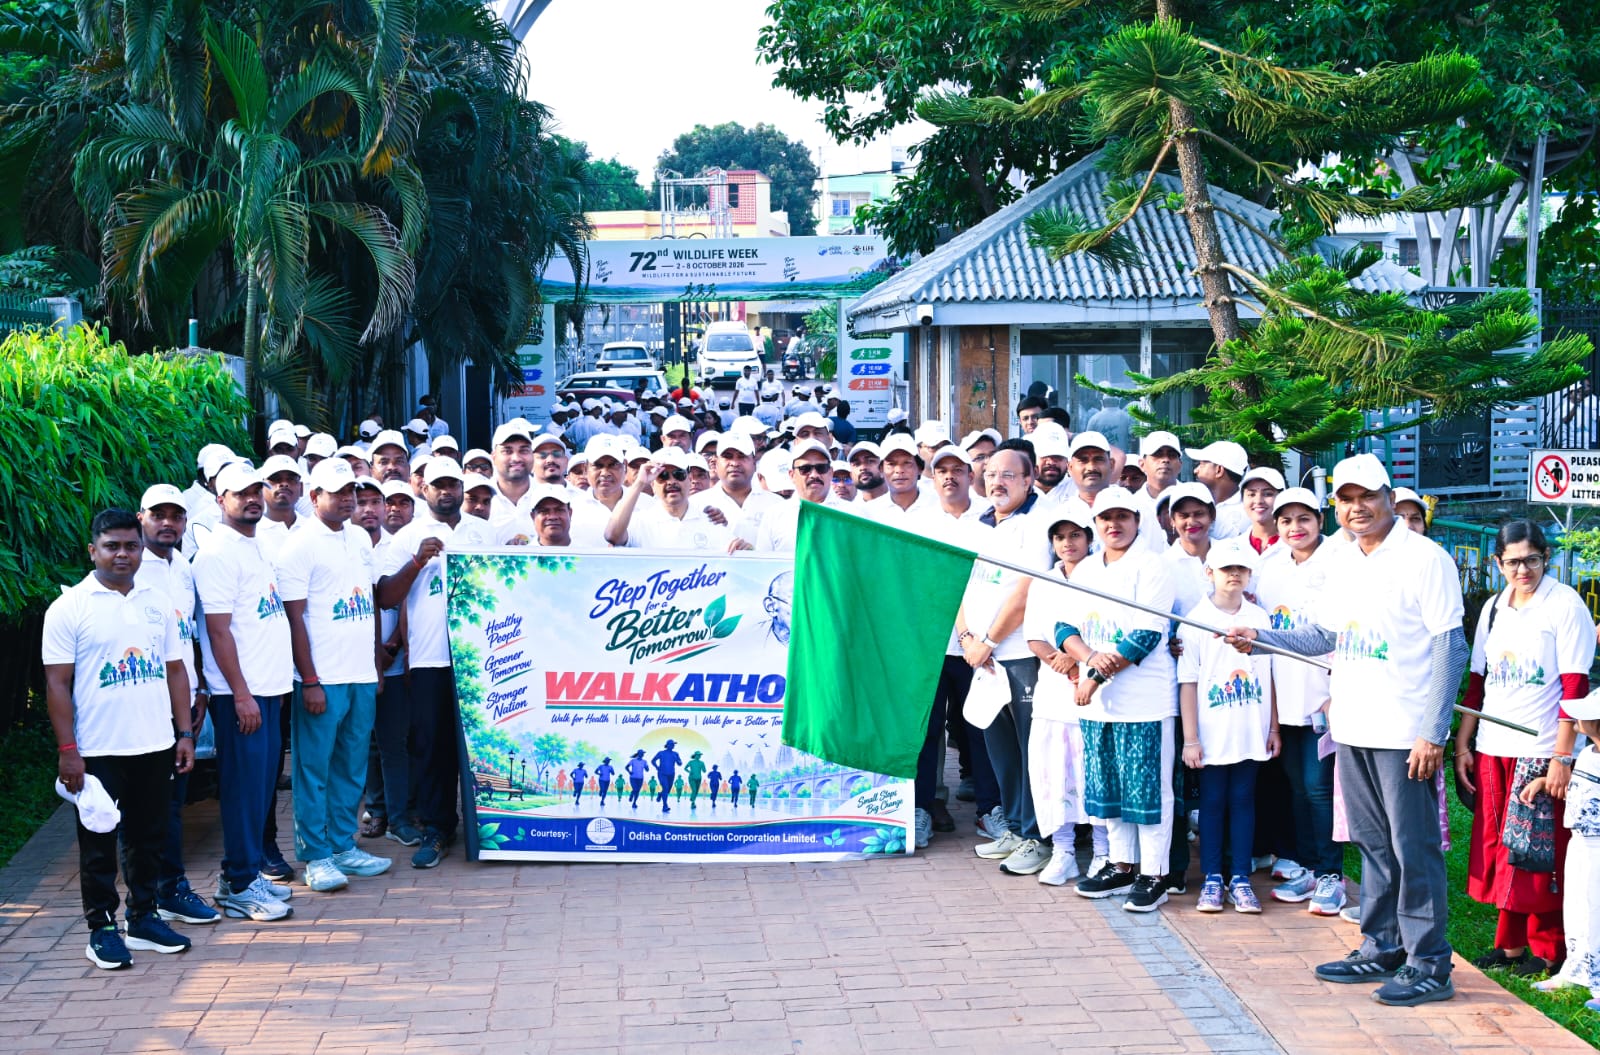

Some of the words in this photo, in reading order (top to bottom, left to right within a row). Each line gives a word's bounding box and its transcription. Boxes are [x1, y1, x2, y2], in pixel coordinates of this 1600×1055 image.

[629, 248, 668, 272] 72nd
[673, 250, 724, 260] WILDLIFE
[728, 249, 758, 259] WEEK
[1571, 473, 1584, 482] DO
[1586, 473, 1599, 482] NO
[1572, 489, 1600, 499] LITTER
[590, 578, 646, 619] Step
[647, 563, 726, 600] Together
[644, 601, 660, 615] for
[484, 613, 522, 636] Healthy
[605, 606, 702, 651] Better
[488, 628, 521, 648] People
[626, 628, 708, 665] Tomorrow
[484, 650, 524, 671] Greener
[489, 659, 532, 682] Tomorrow
[545, 671, 786, 703] WALKATHO
[486, 686, 528, 710] Stronger
[493, 700, 528, 720] Nation
[551, 713, 570, 723] Walk
[570, 714, 583, 726] for
[585, 713, 609, 723] Health
[622, 714, 641, 724] Walk
[641, 714, 654, 726] for
[656, 714, 689, 727] Harmony
[702, 715, 721, 725] Walk
[721, 716, 734, 728] for
[744, 715, 768, 726] Better
[857, 792, 878, 808] Small
[879, 790, 897, 801] Steps
[866, 804, 879, 815] Big
[880, 799, 903, 810] Change
[530, 830, 572, 840] Courtesy:-
[629, 831, 661, 841] Odisha
[664, 832, 724, 841] Construction
[727, 832, 781, 843] Corporation
[782, 833, 818, 843] Limited.
